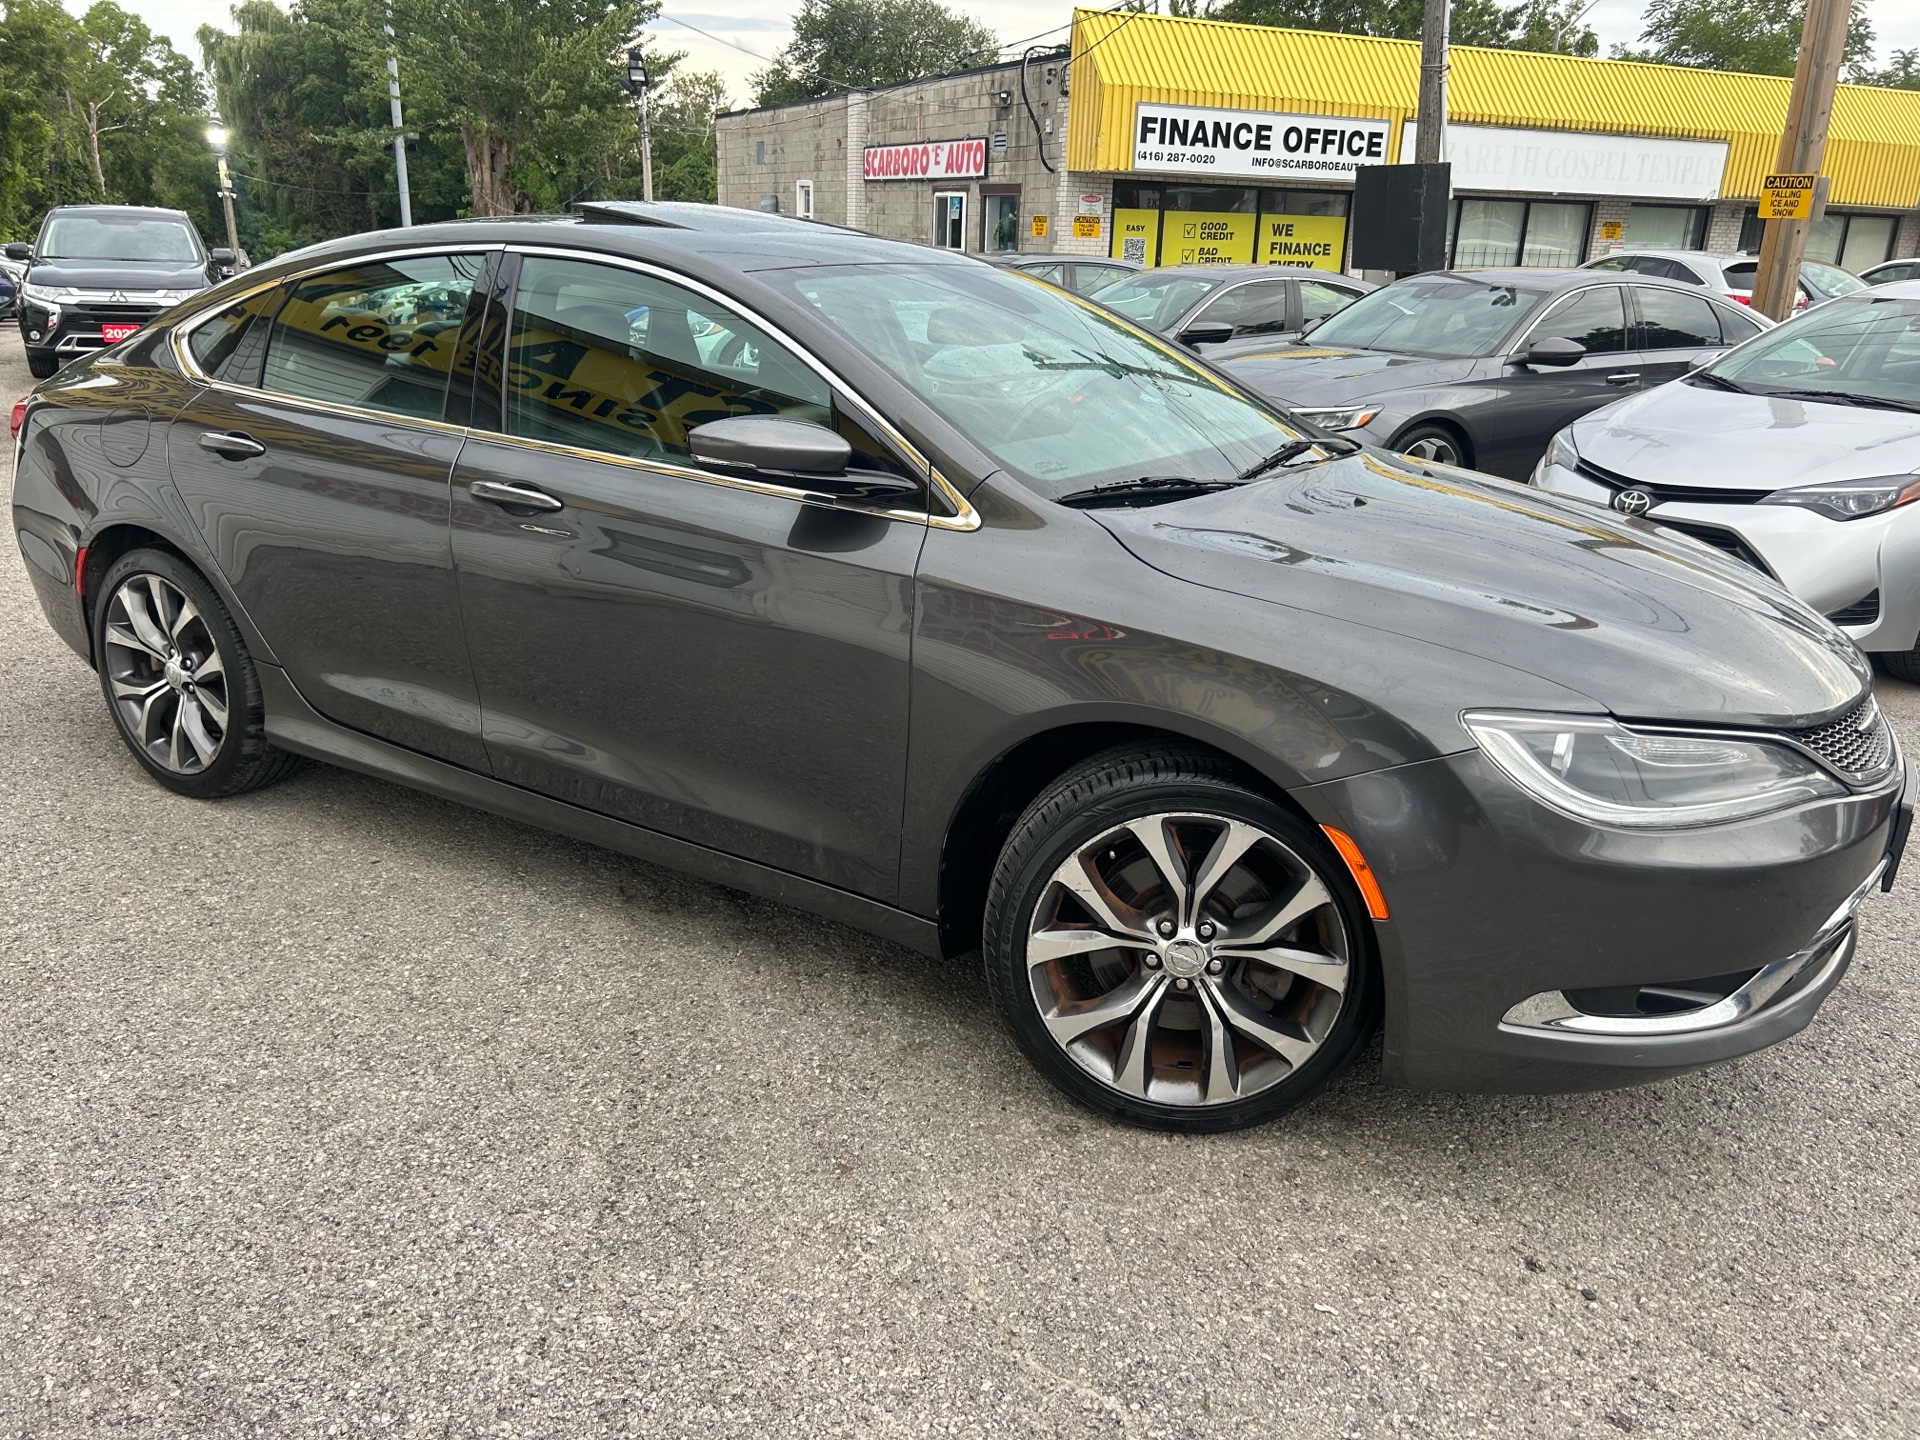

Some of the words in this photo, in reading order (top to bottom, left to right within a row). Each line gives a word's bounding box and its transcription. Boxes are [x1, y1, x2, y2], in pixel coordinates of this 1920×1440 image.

[1139, 115, 1273, 152] FINANCE
[1282, 125, 1385, 158] OFFICE
[864, 145, 930, 177] SCARBORO
[944, 141, 984, 174] AUTO
[1137, 150, 1164, 162] (416)
[1166, 152, 1216, 165] 287-0020
[1544, 146, 1631, 183] GOSPEL
[1636, 151, 1721, 186] TEMPLE
[1766, 176, 1812, 188] CAUTION
[1771, 190, 1802, 198] FALLING
[1770, 199, 1782, 208] ICE
[1783, 199, 1799, 208] AND
[1771, 208, 1795, 217] SNOW
[1075, 216, 1099, 224] CAUTION
[1126, 224, 1146, 232] EASY
[1200, 221, 1229, 231] GOOD
[1271, 223, 1294, 237] WE
[1199, 231, 1235, 241] CREDIT
[1197, 247, 1219, 256] BAD
[1269, 242, 1332, 257] FINANCE
